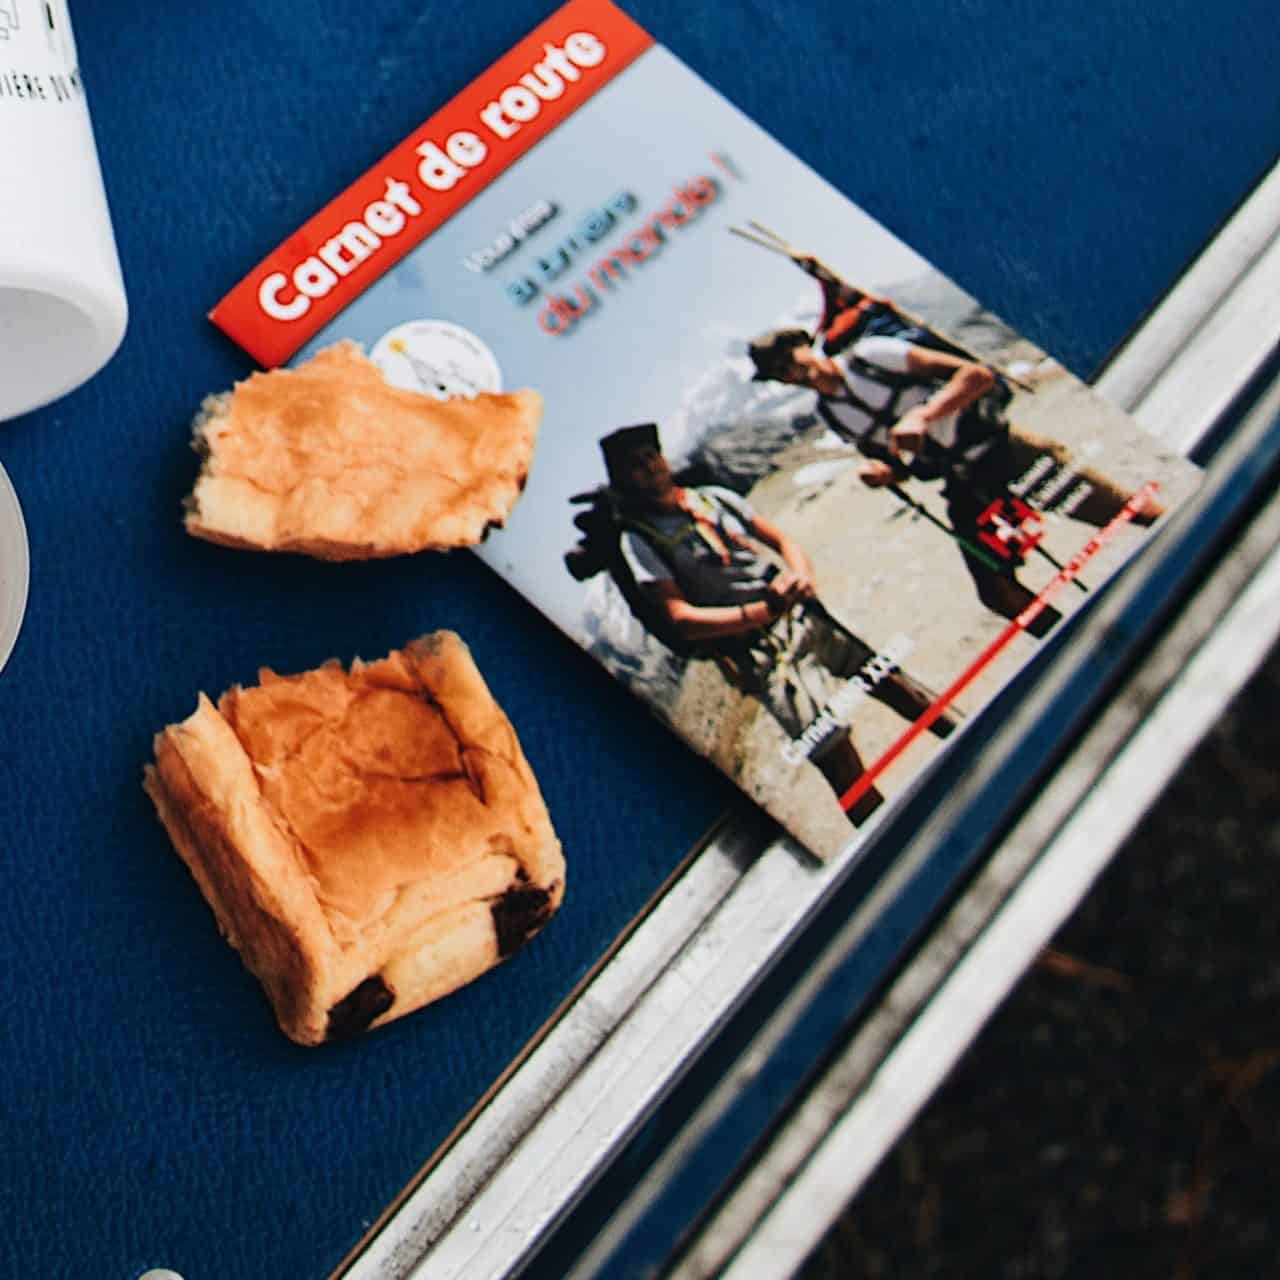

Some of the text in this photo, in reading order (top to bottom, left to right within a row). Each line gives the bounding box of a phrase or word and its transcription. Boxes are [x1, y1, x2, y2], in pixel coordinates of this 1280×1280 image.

[259, 176, 422, 321] Carnet
[416, 131, 487, 192] de
[481, 31, 607, 141] route
